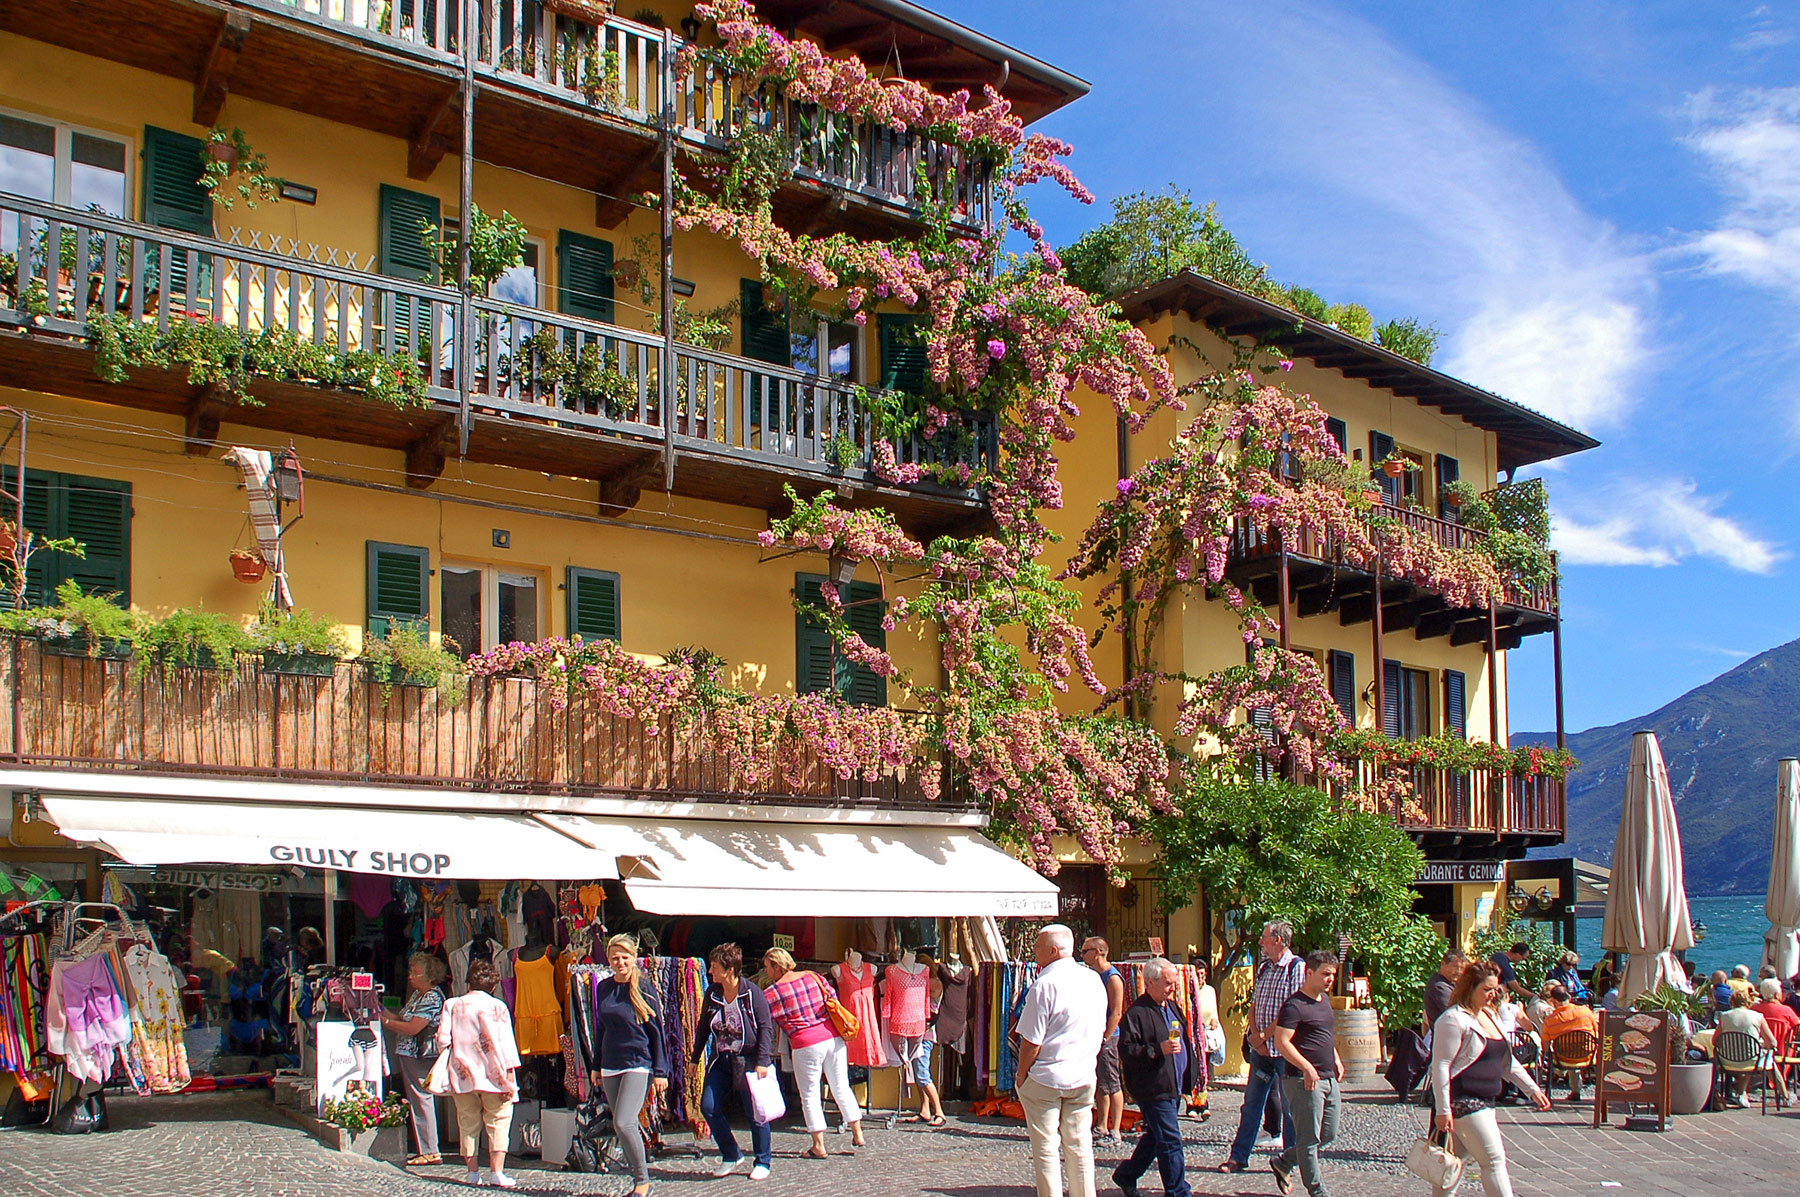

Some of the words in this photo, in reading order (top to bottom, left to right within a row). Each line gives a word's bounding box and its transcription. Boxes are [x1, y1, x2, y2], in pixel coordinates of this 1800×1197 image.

[269, 845, 358, 868] GIULY
[370, 851, 451, 875] SHOP
[154, 870, 216, 887] GIULY
[223, 873, 282, 891] SHOP
[1418, 864, 1464, 880] ORANTE
[1469, 864, 1504, 879] GEMMA
[1602, 1035, 1613, 1061] SNACK
